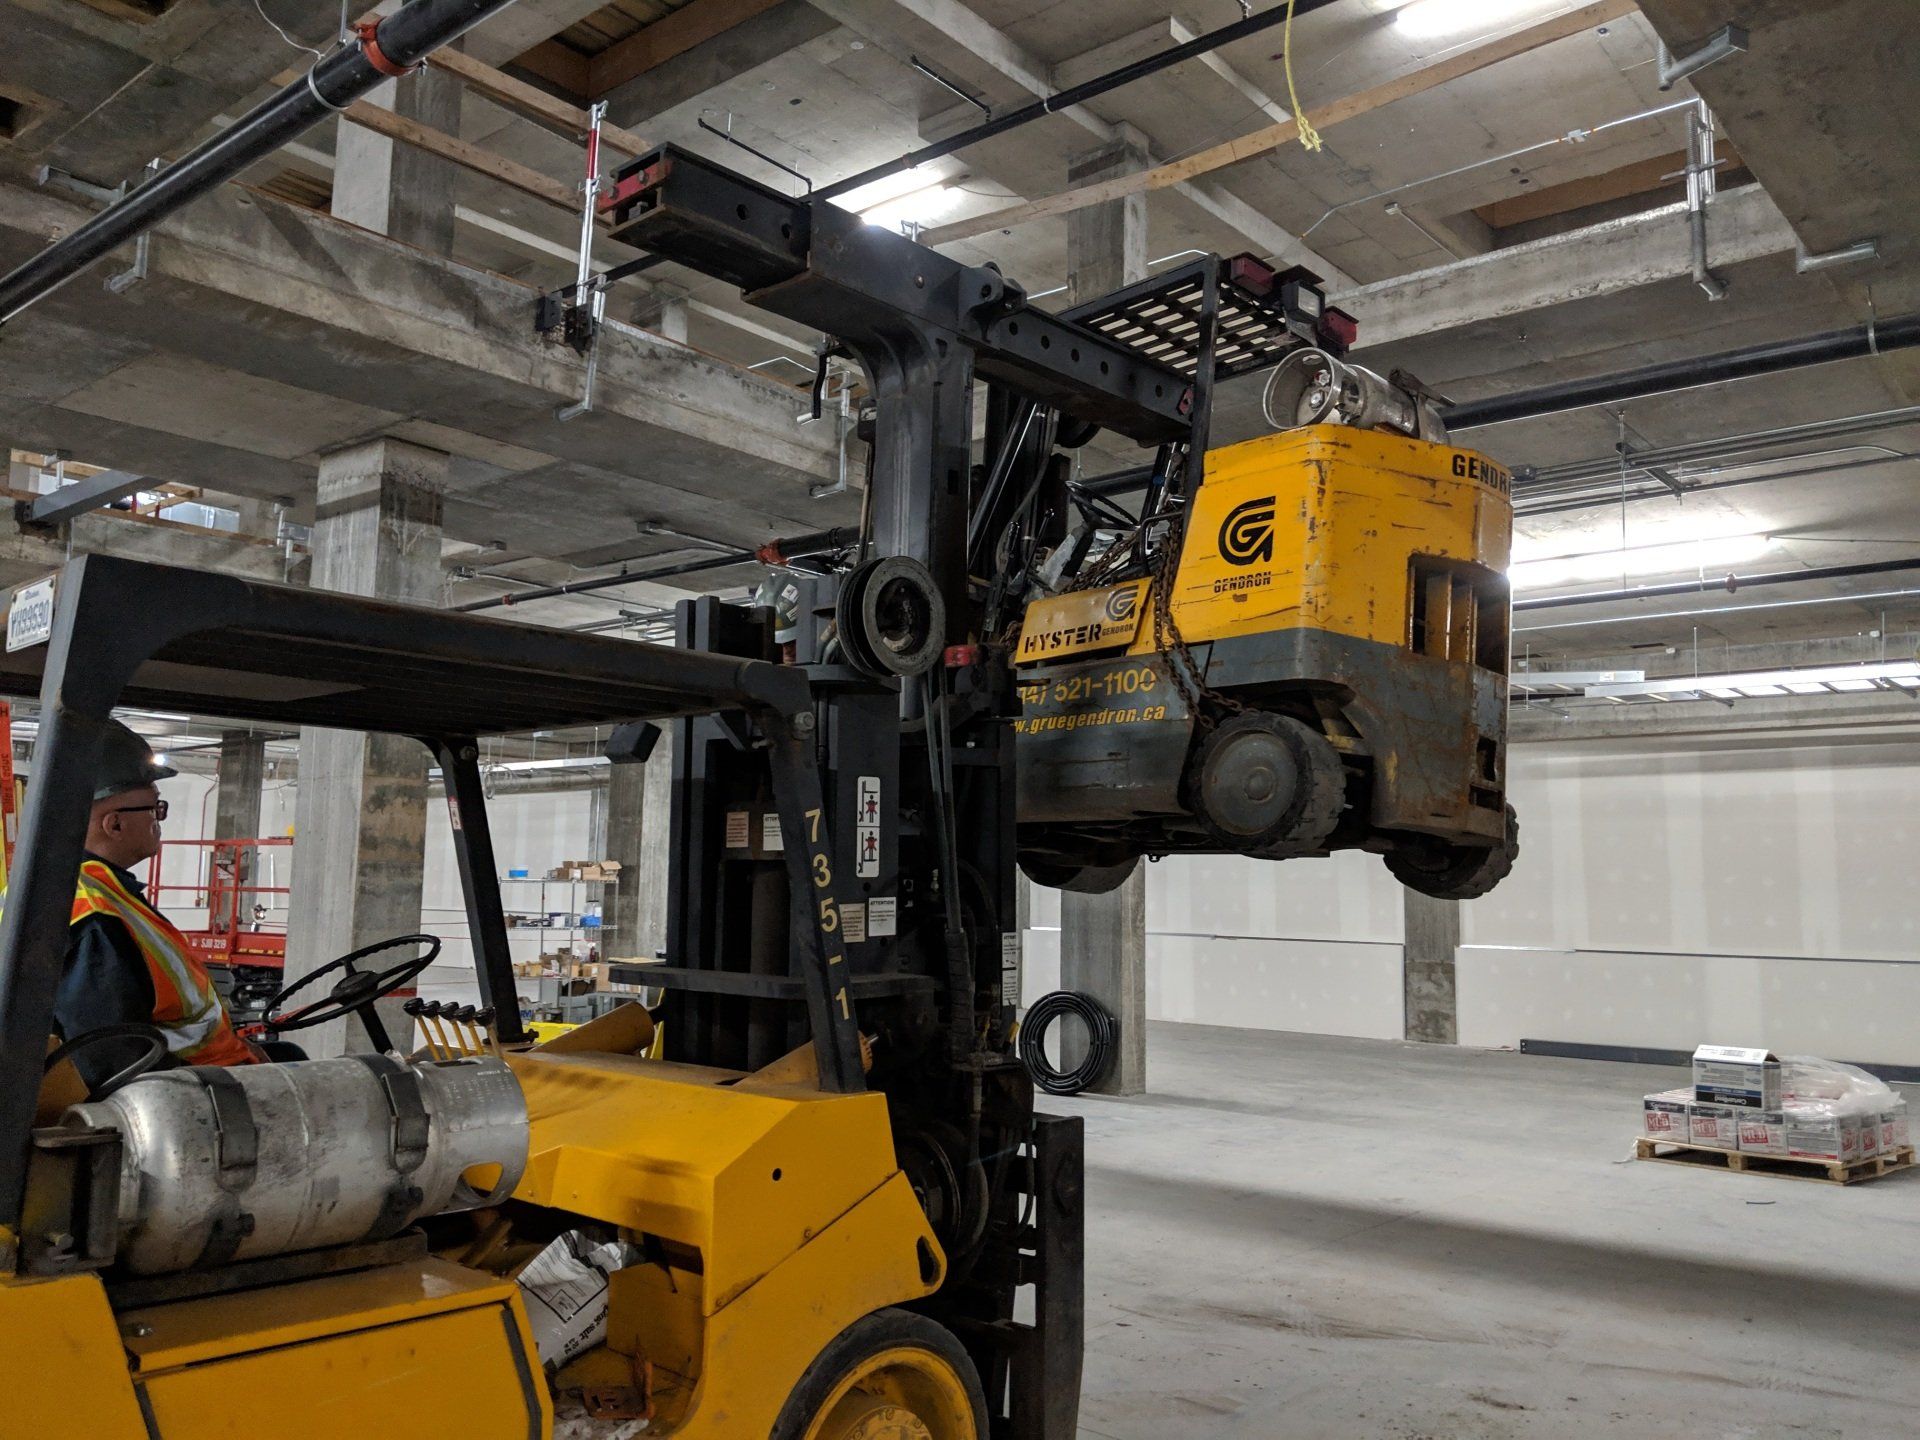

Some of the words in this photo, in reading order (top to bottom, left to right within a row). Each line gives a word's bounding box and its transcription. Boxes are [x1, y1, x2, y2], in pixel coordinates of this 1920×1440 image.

[1452, 453, 1511, 497] GENDR
[1213, 571, 1272, 593] GENDRON
[1024, 623, 1102, 654] HYSTER
[1054, 665, 1157, 702] 521-1100
